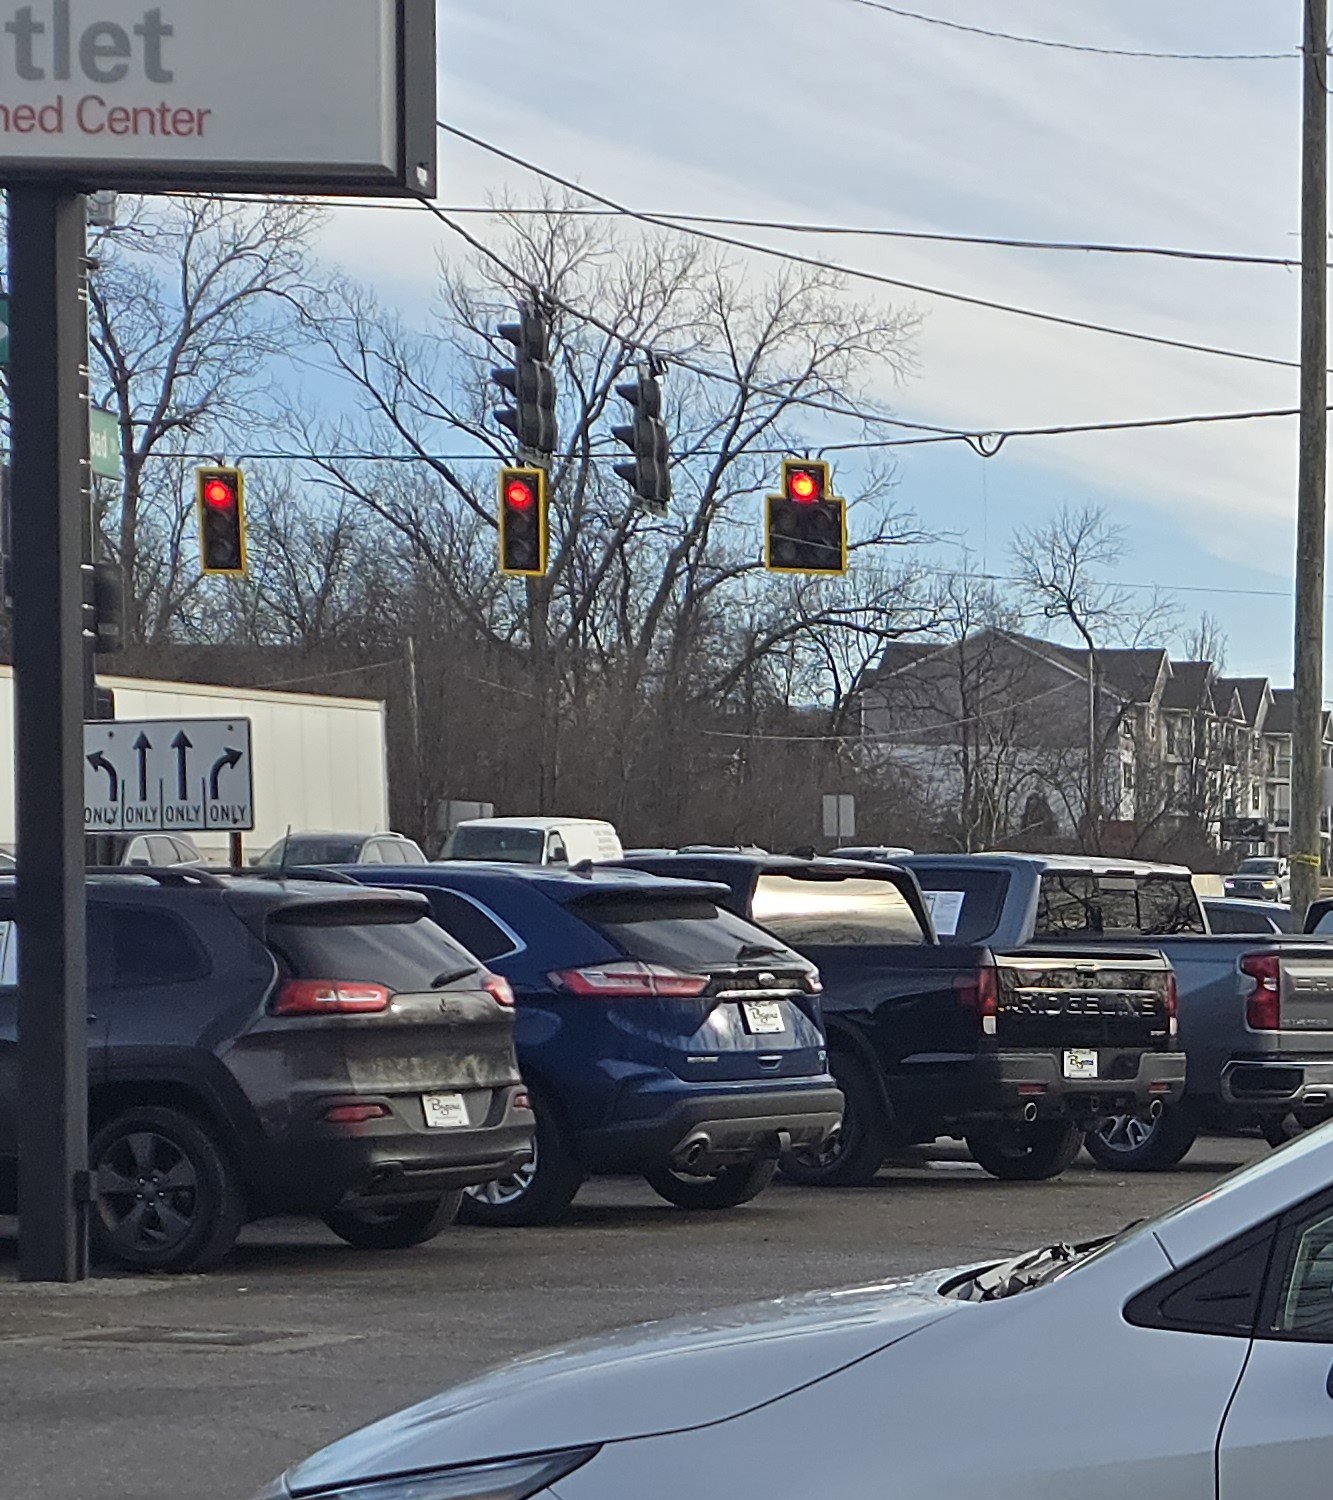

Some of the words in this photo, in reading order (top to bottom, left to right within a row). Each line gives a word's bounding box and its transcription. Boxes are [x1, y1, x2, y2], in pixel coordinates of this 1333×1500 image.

[4, 0, 174, 83] tlet
[76, 94, 211, 136] Center
[84, 806, 118, 824] ONLY
[125, 806, 158, 824] ONLY
[165, 805, 201, 823] ONLY
[209, 804, 248, 824] ONLY
